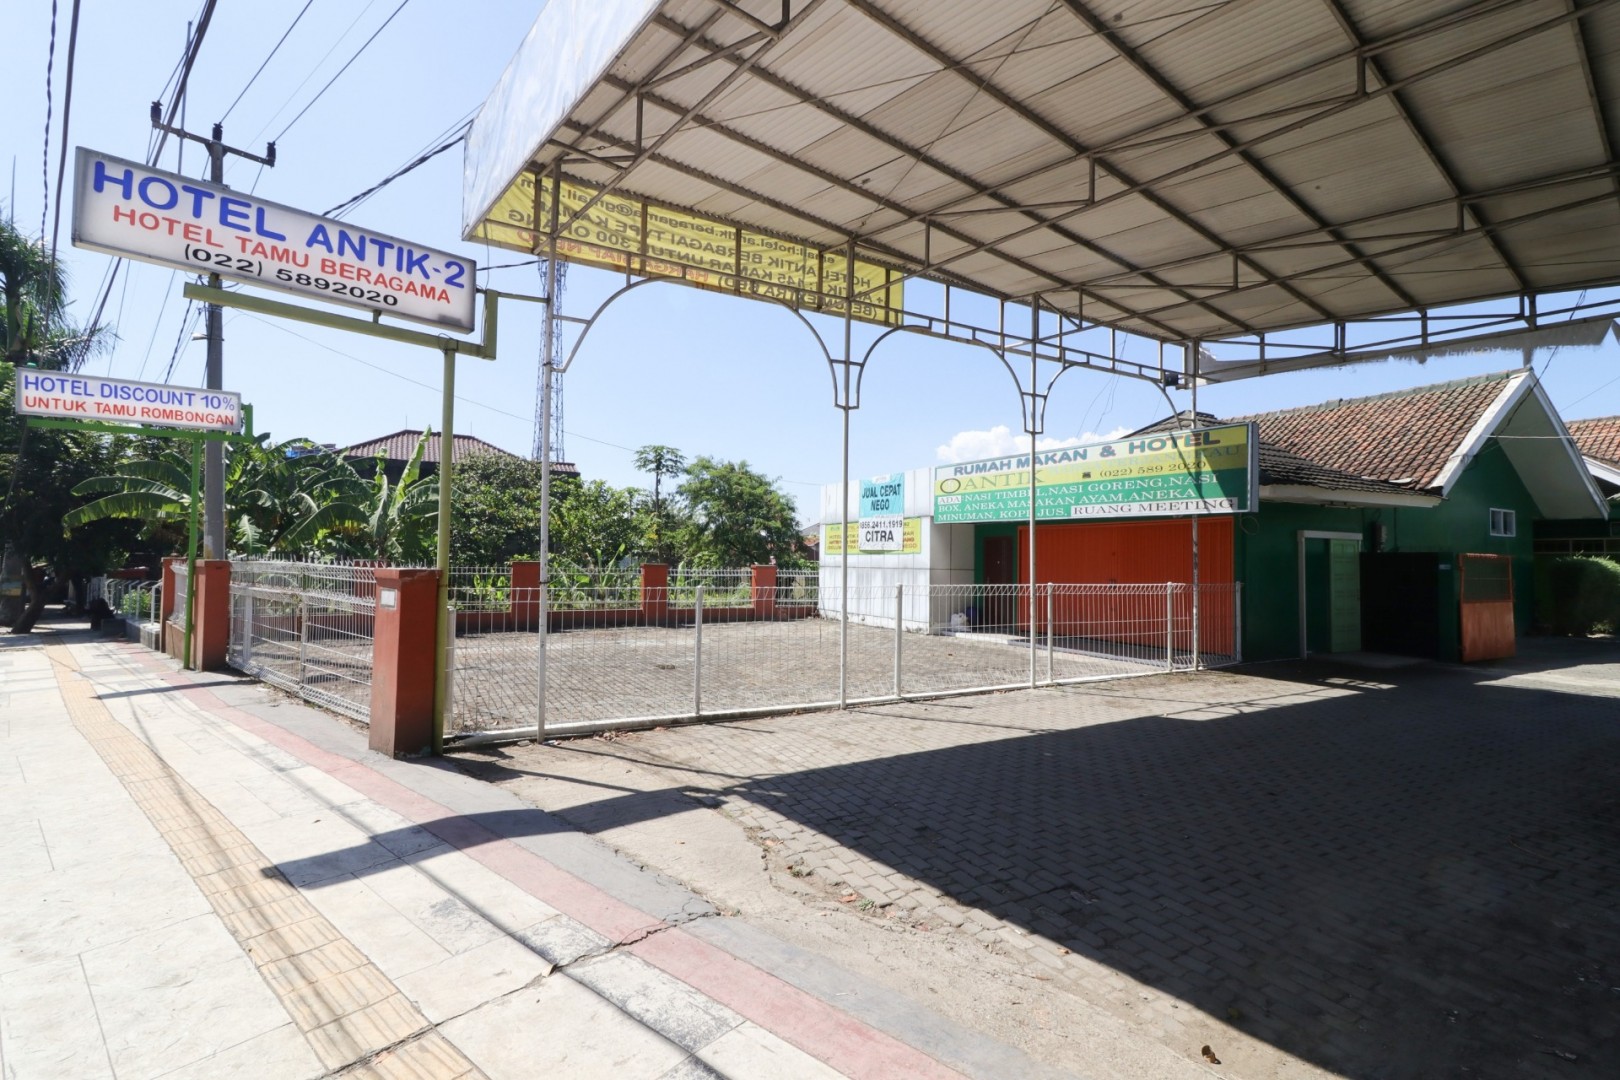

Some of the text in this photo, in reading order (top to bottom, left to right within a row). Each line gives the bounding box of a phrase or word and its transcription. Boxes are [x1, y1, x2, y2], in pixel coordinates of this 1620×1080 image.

[93, 160, 465, 289] HOTEL ANTIK-2
[113, 205, 451, 304] HOTEL TAMU BERAGAMA
[184, 243, 398, 306] (022) 5892020
[24, 374, 235, 411] HOTEL DISCOUNT 10%
[25, 395, 234, 426] UNTUK TAMU ROMBONGAN
[954, 460, 1011, 476] RUMAH
[1016, 449, 1088, 469] MAKAN
[1100, 445, 1116, 458] &
[1128, 432, 1220, 454] HOTEL
[1100, 467, 1132, 478] (022)
[1138, 465, 1163, 474] 589
[1169, 461, 1206, 472] 2020
[962, 470, 1045, 490] ANTIK
[862, 483, 902, 498] JUAL CEPAT
[870, 498, 890, 511] NEGO
[939, 496, 960, 504] ADA
[964, 502, 1005, 510] ANEKA
[1074, 504, 1132, 515] RUANG
[1138, 499, 1234, 512] MEETING
[866, 530, 894, 542] CITRA
